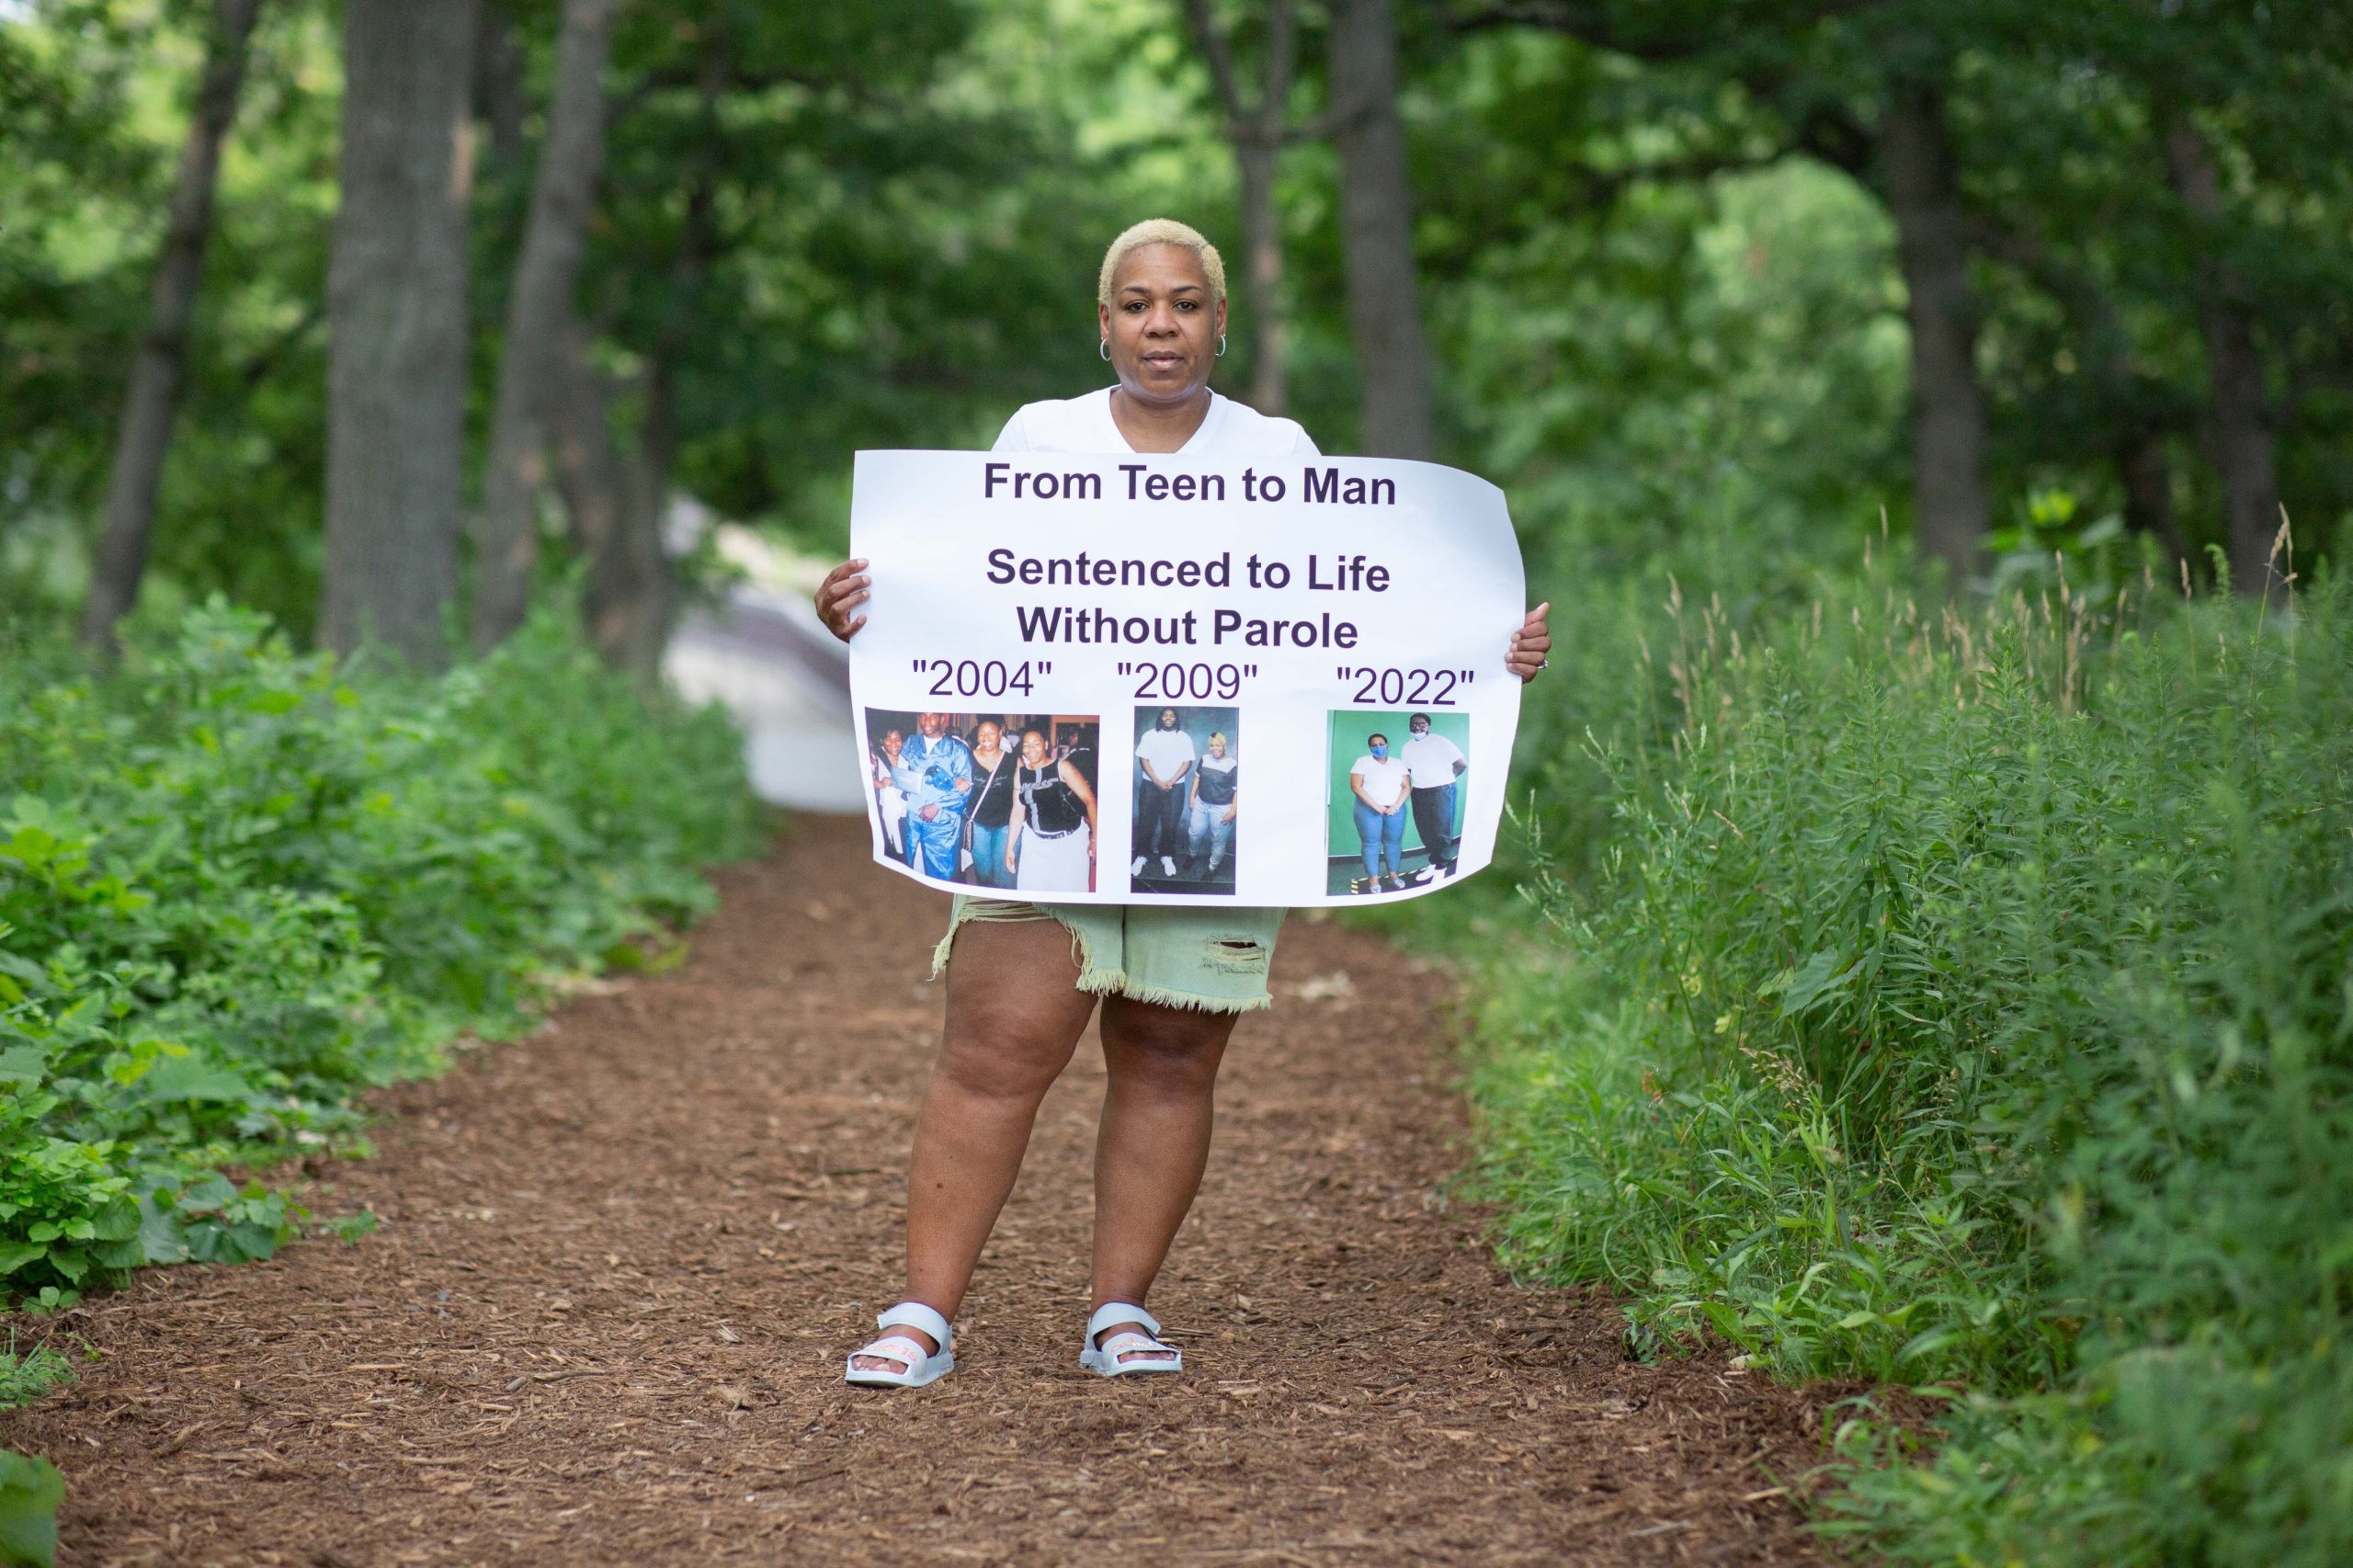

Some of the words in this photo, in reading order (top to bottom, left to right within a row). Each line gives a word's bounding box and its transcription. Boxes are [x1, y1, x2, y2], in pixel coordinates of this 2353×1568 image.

[984, 462, 1101, 500] From
[1119, 464, 1225, 501] Teen
[1242, 467, 1286, 503] to
[1303, 467, 1395, 506] Man
[986, 549, 1230, 587] Sentenced
[1246, 553, 1290, 589] to
[1309, 554, 1390, 593] Life
[1016, 606, 1197, 645] Without
[1214, 609, 1358, 649] Parole
[913, 659, 1051, 697] "2004"
[1118, 662, 1257, 700] "2009"
[1337, 666, 1474, 706] "2022"
